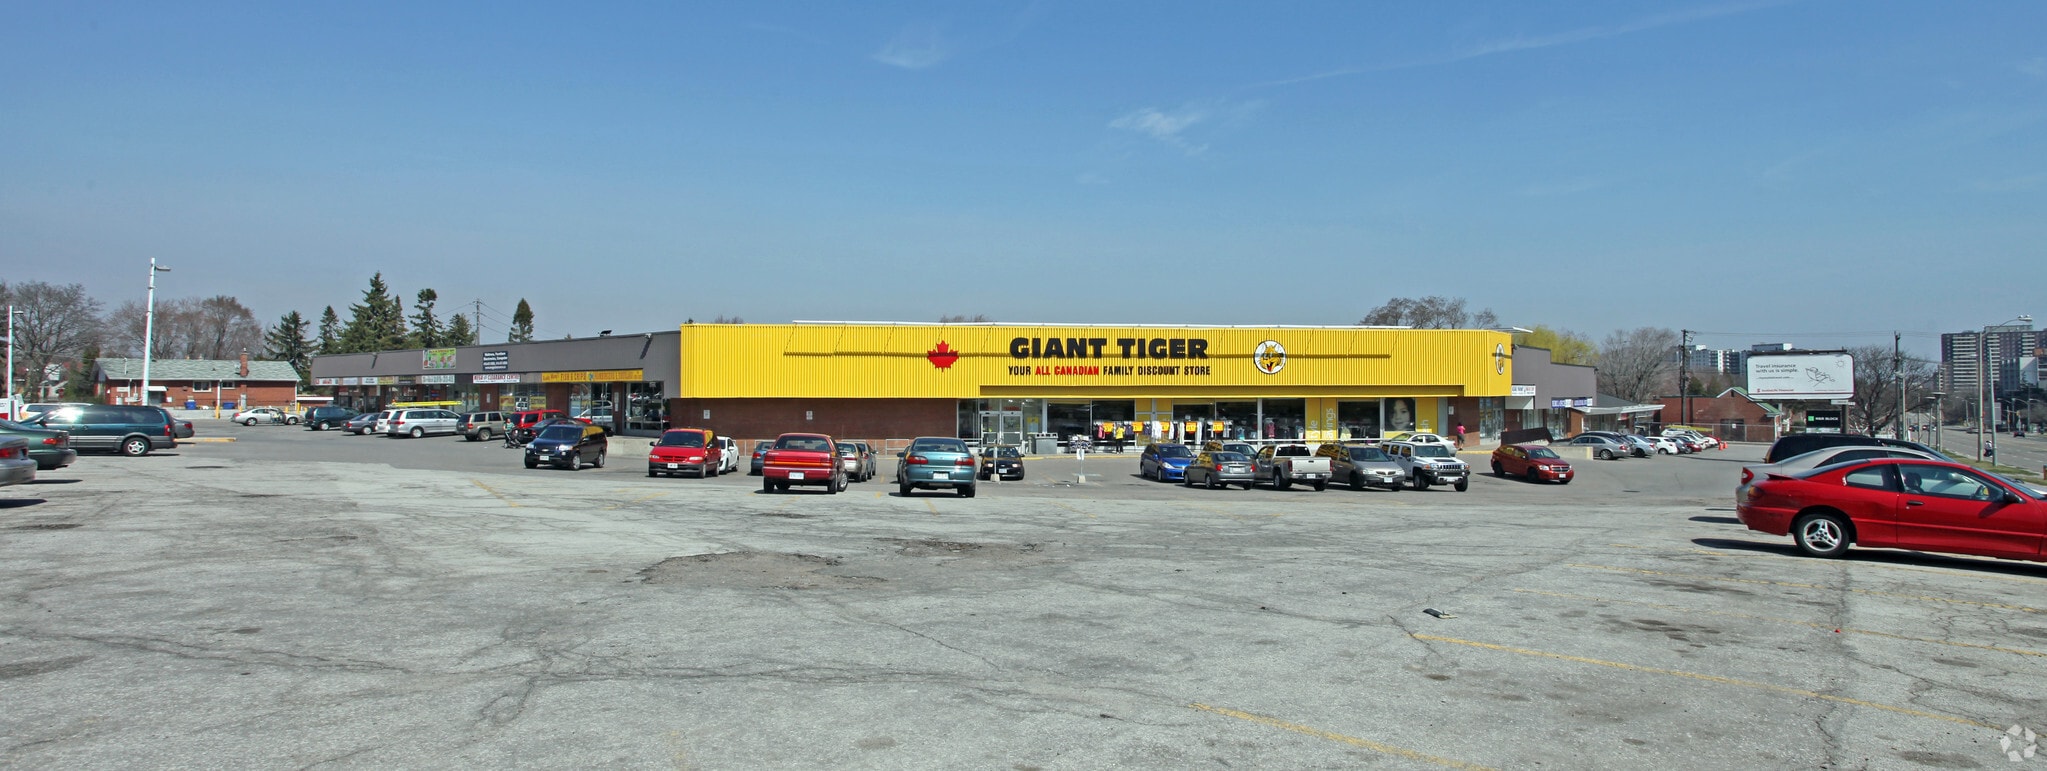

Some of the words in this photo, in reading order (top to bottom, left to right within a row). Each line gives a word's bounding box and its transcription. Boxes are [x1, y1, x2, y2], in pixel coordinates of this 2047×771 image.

[1009, 337, 1107, 359] GIANT
[1117, 337, 1209, 359] TIGER
[1008, 366, 1031, 376] YOUR
[1035, 366, 1051, 376] ALL
[1054, 366, 1099, 376] CANADIAN
[1103, 366, 1134, 376] FAMILY
[1138, 366, 1181, 376] DISCOUNT
[1184, 366, 1211, 376] STORE
